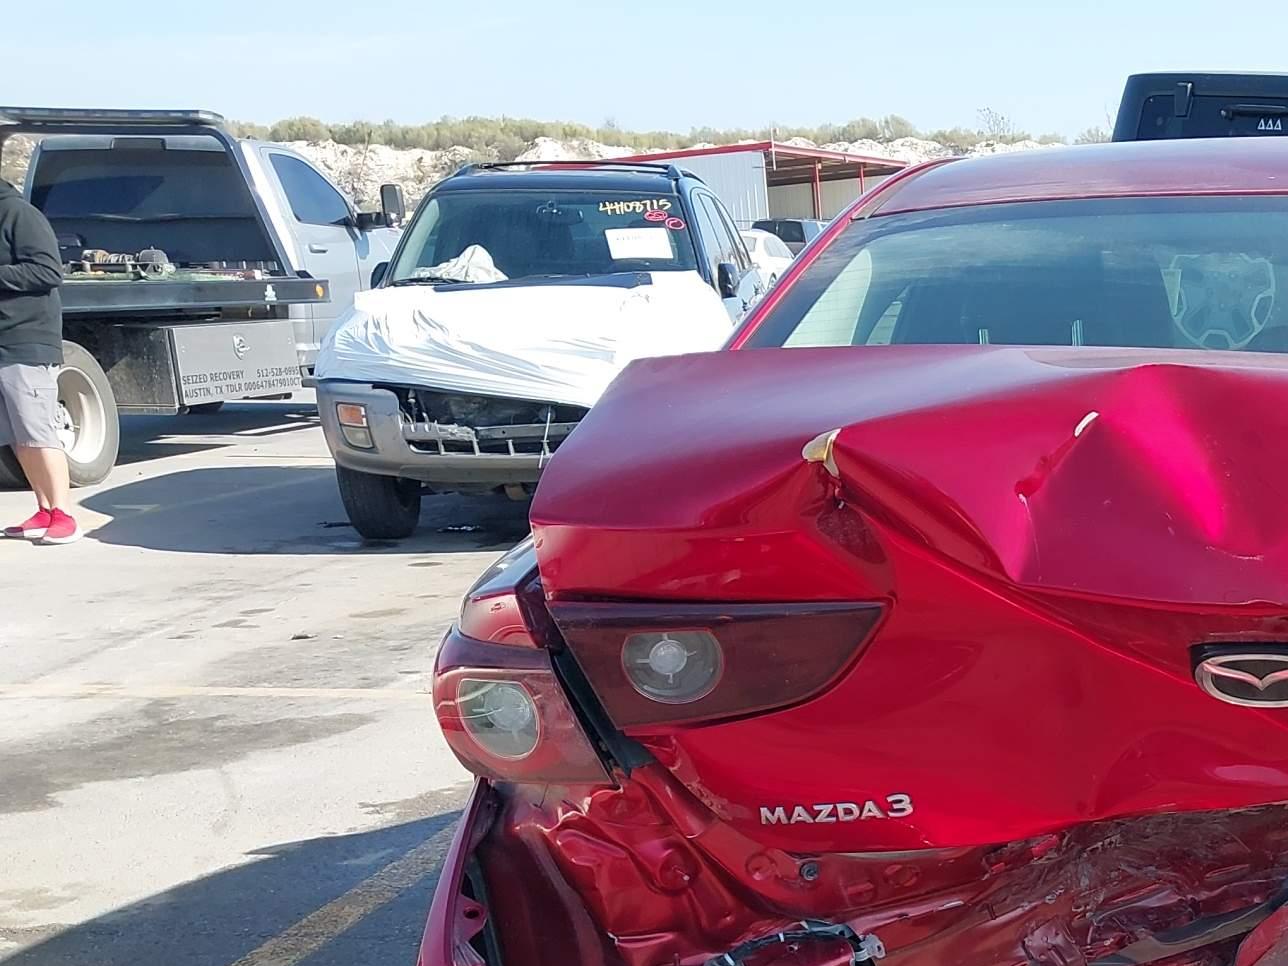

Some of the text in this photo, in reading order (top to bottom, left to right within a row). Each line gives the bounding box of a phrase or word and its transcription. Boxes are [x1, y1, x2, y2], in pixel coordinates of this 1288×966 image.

[599, 199, 672, 215] 44108715
[182, 370, 244, 385] SEIZED RECOVERY
[184, 386, 212, 399] AUSTIN,
[215, 384, 224, 395] TX
[226, 382, 242, 393] TDLR
